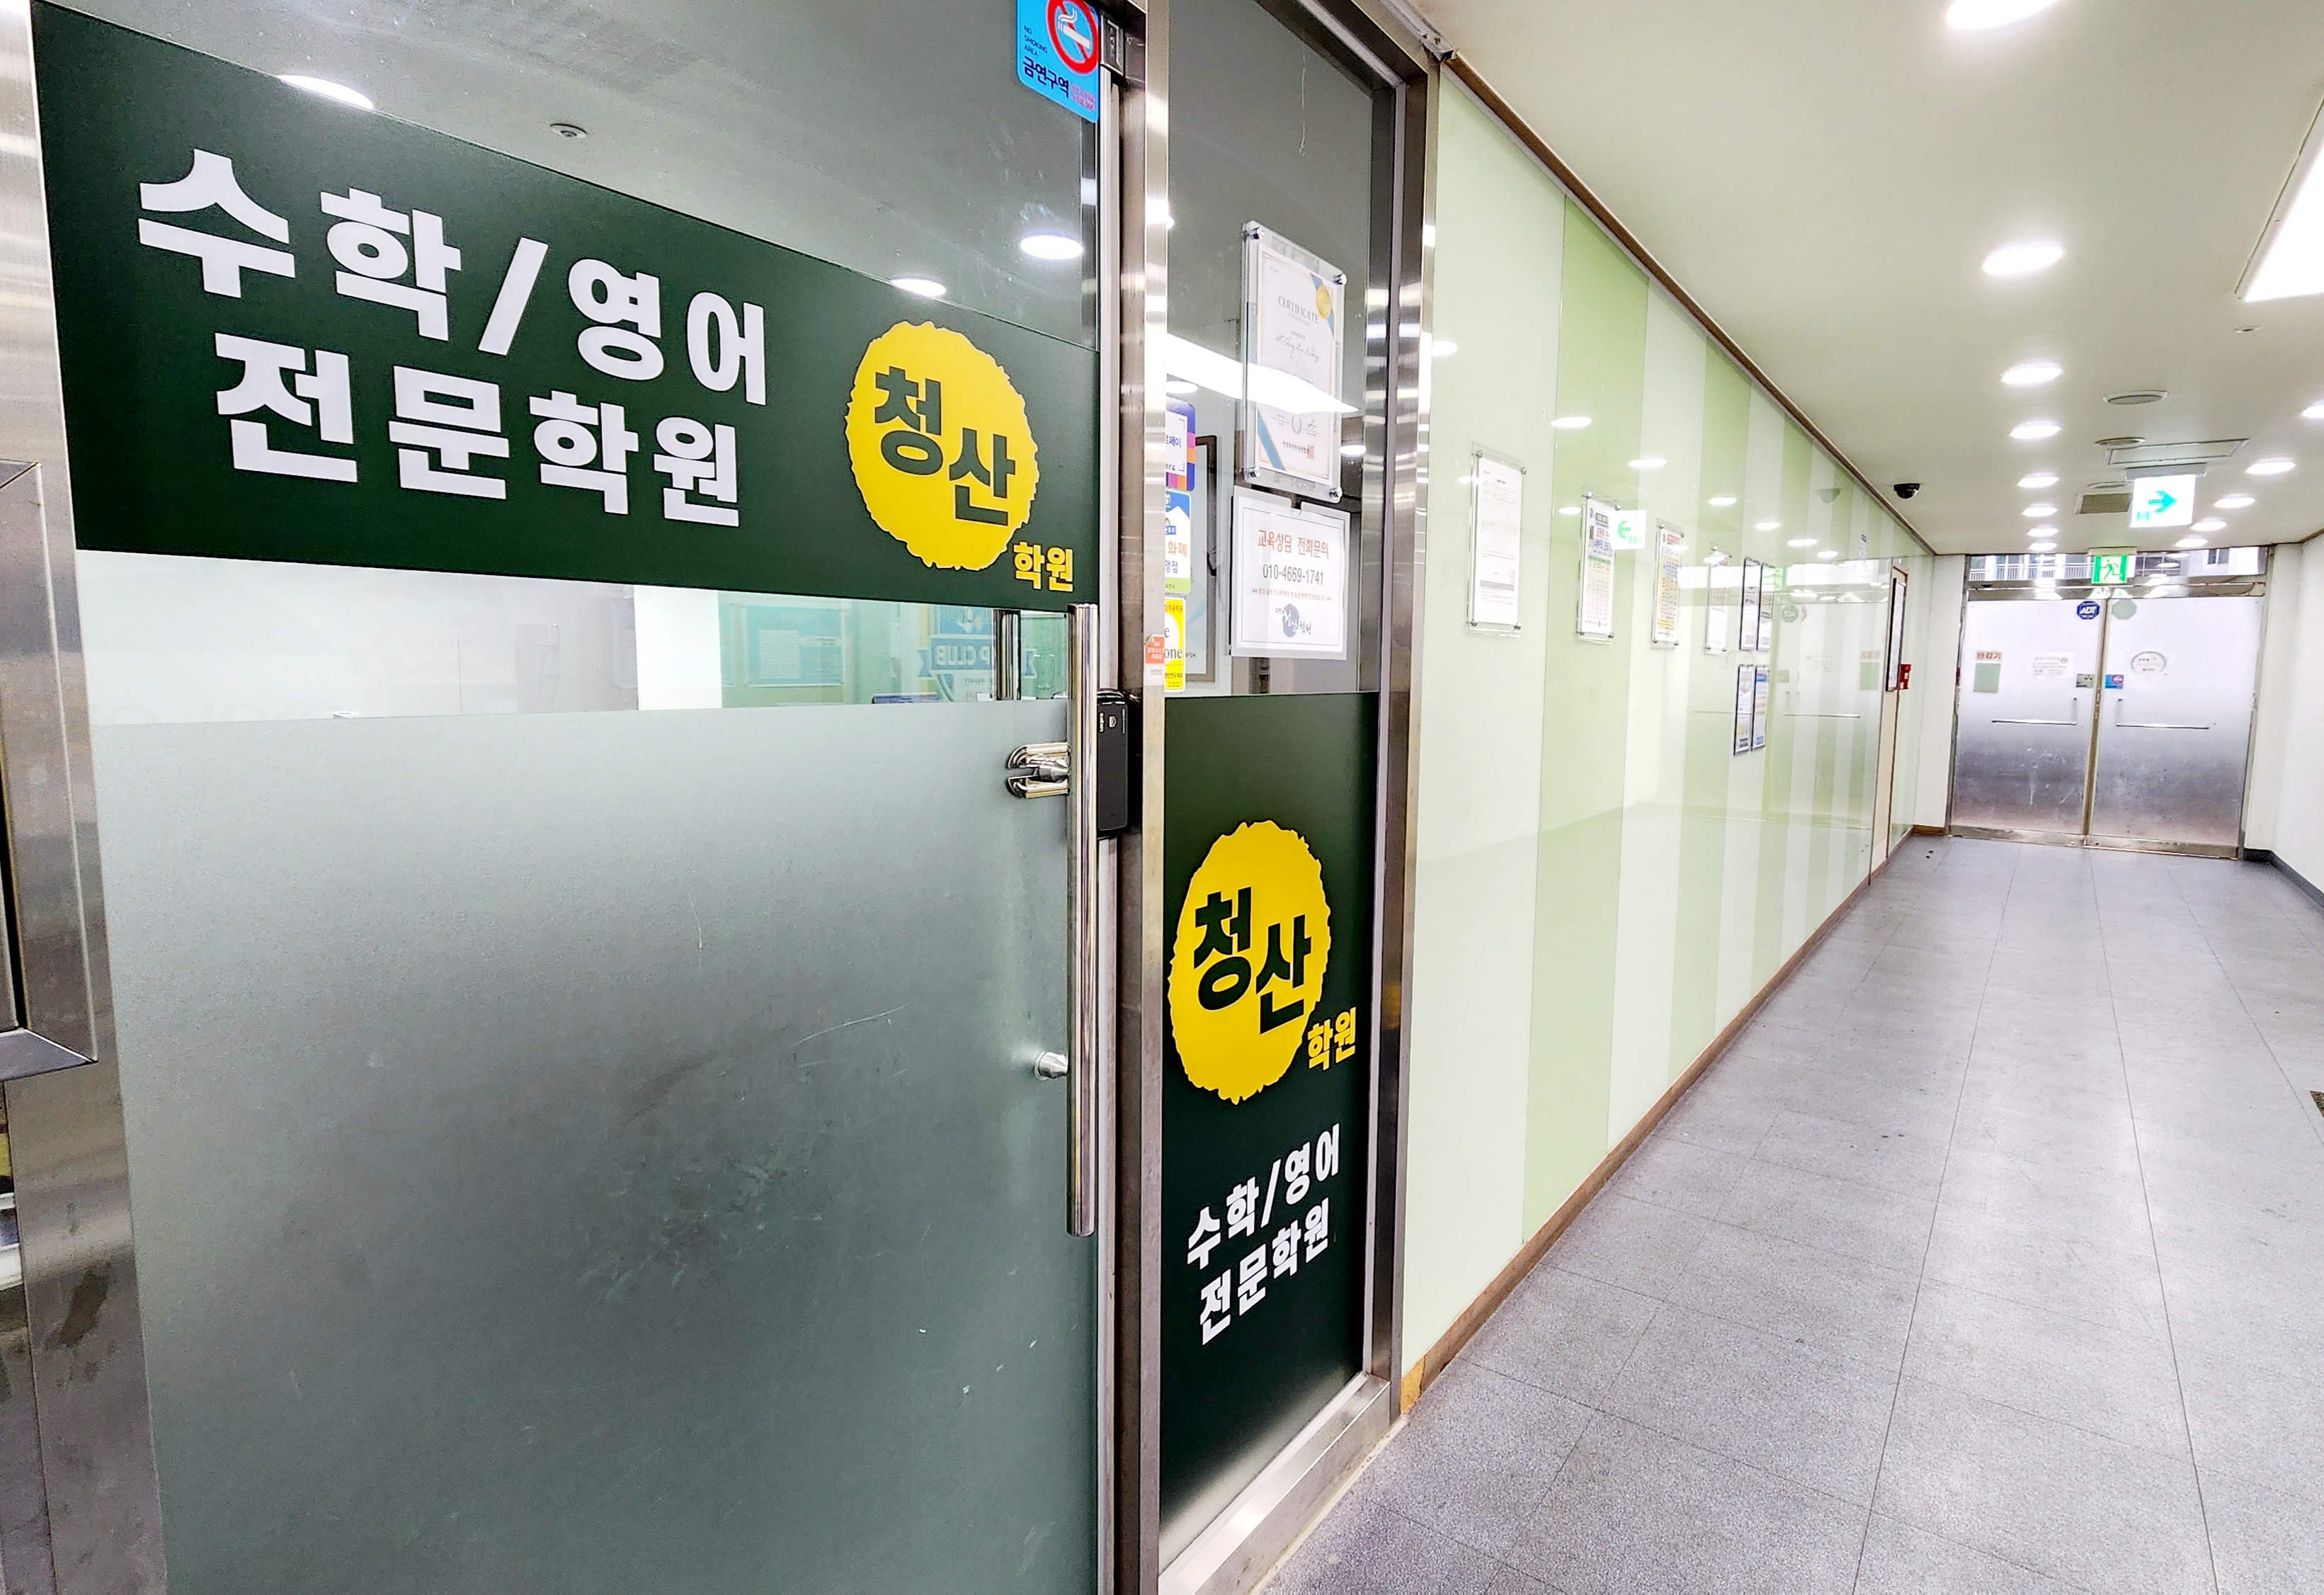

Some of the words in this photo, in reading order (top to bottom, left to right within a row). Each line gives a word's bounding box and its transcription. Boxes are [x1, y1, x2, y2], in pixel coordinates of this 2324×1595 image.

[1024, 25, 1032, 35] NO
[1024, 35, 1048, 54] SMOKING
[1024, 44, 1039, 57] AREA
[1023, 55, 1069, 98] 금연구역
[138, 148, 766, 405] 수학/영어
[1278, 296, 1319, 324] CERTIFICATE
[214, 332, 739, 527] 전문학원
[875, 365, 1016, 527] 청산
[1013, 540, 1074, 593] 학원
[1168, 540, 1187, 558] 화폐
[1258, 530, 1292, 552] 교육상담
[1298, 537, 1329, 560] 전화문의
[1263, 564, 1323, 586] 010-4669-1741
[1194, 886, 1311, 1035] 청산
[1307, 1006, 1356, 1071] 학원
[1187, 1123, 1340, 1270] 수학/영어
[1200, 1197, 1328, 1345] 전문학원
